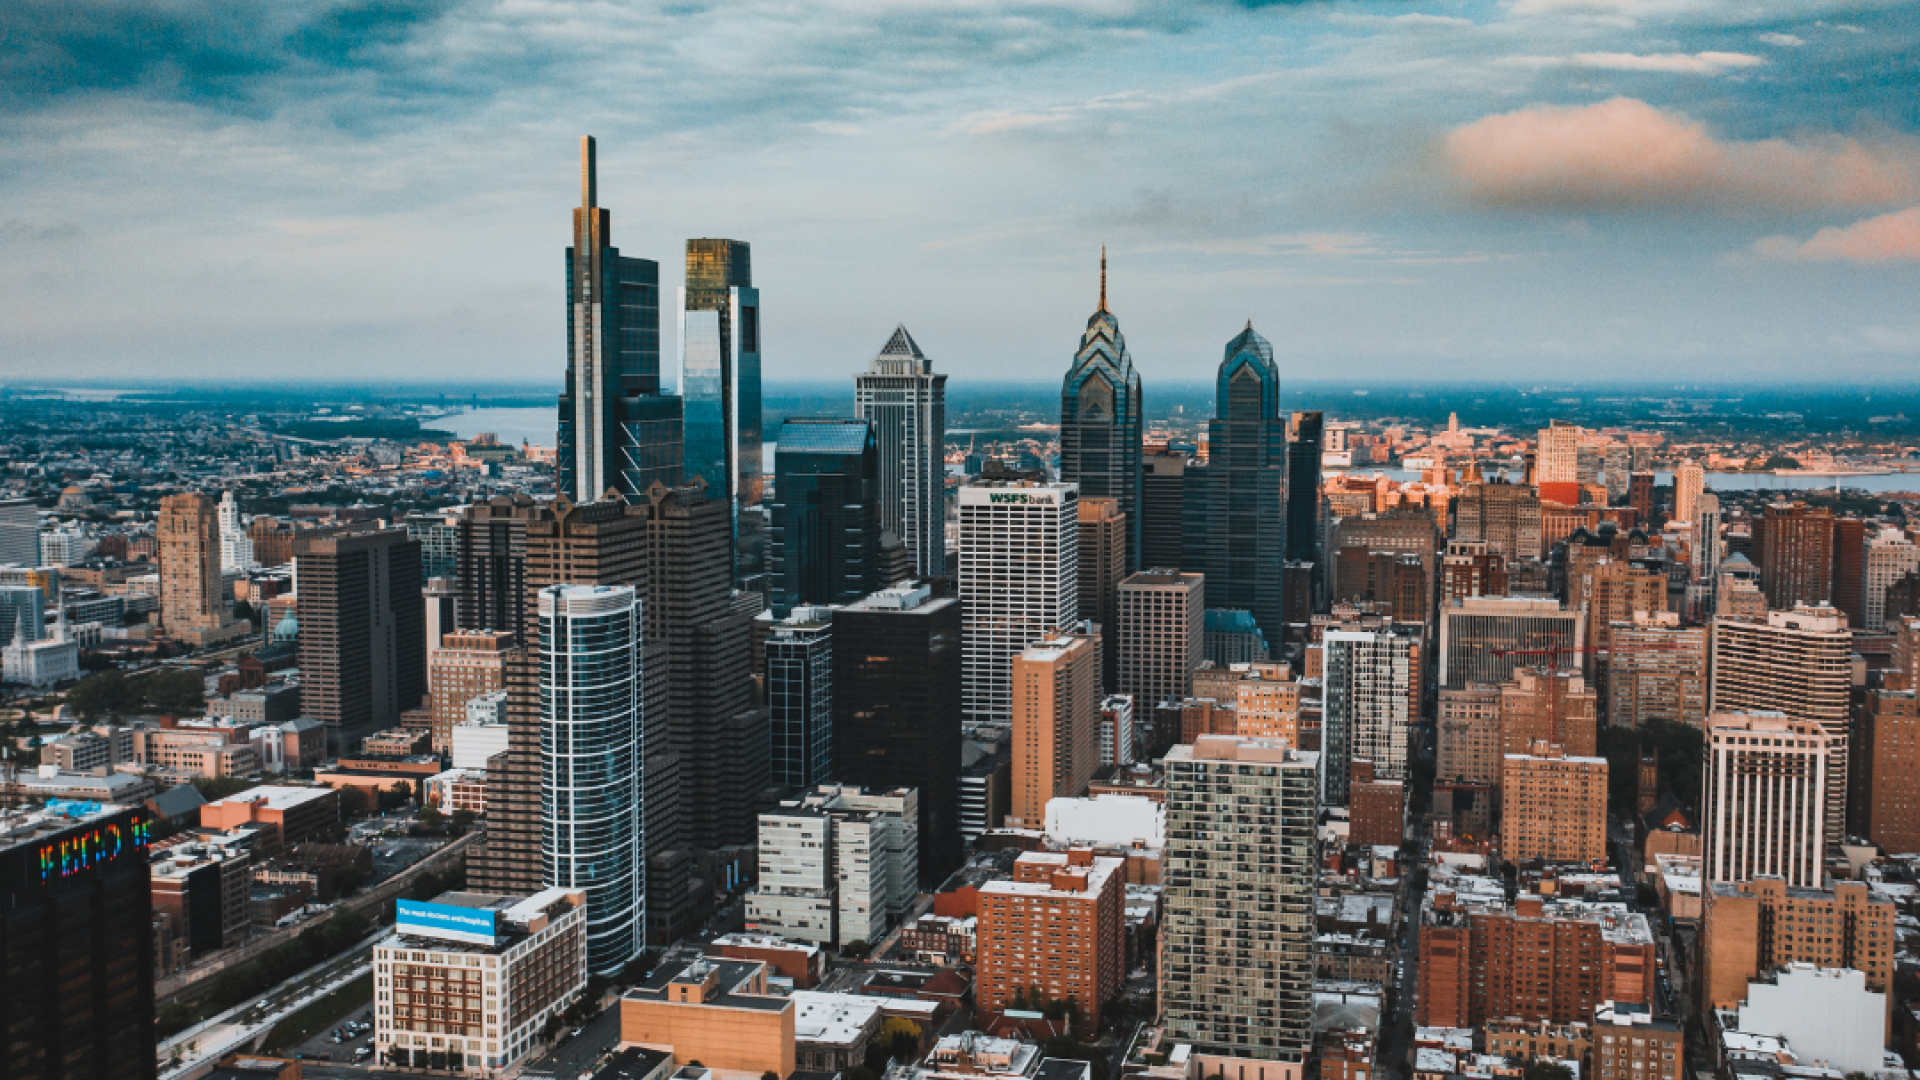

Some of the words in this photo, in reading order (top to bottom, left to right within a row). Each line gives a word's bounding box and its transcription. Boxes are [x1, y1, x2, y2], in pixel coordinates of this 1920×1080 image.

[990, 493, 1028, 504] WSFS
[1028, 494, 1054, 504] bank
[399, 907, 410, 915] The
[451, 914, 462, 923] and
